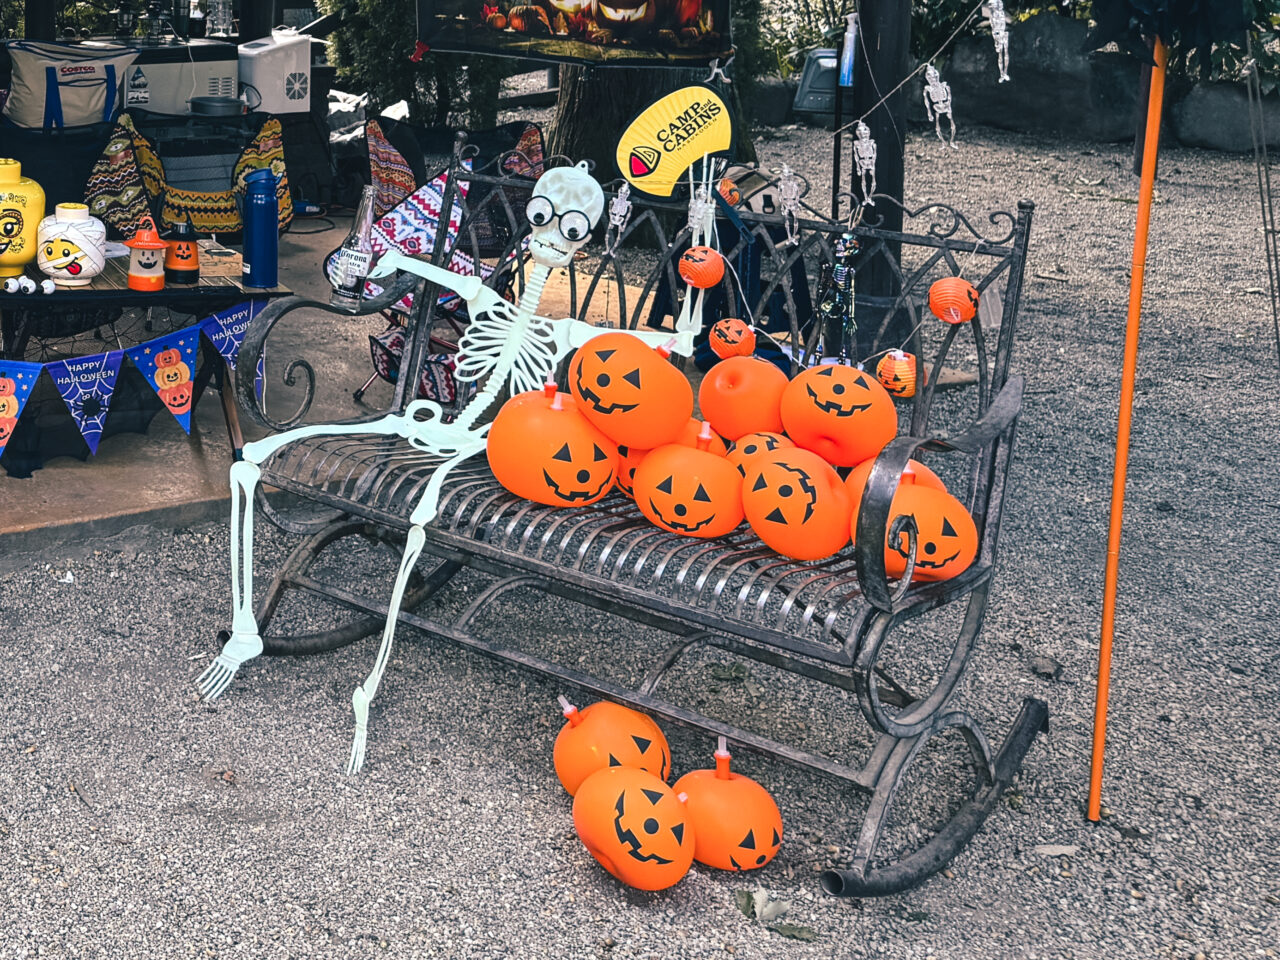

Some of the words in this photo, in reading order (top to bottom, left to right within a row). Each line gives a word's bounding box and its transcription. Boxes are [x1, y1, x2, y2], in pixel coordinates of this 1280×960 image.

[656, 101, 701, 143] CAMP
[700, 99, 713, 111] and
[663, 102, 722, 153] CABINS
[340, 250, 368, 263] Corona
[220, 309, 249, 326] HAPPY
[68, 361, 101, 372] HAPPY
[57, 369, 115, 385] HALLOWEEN
